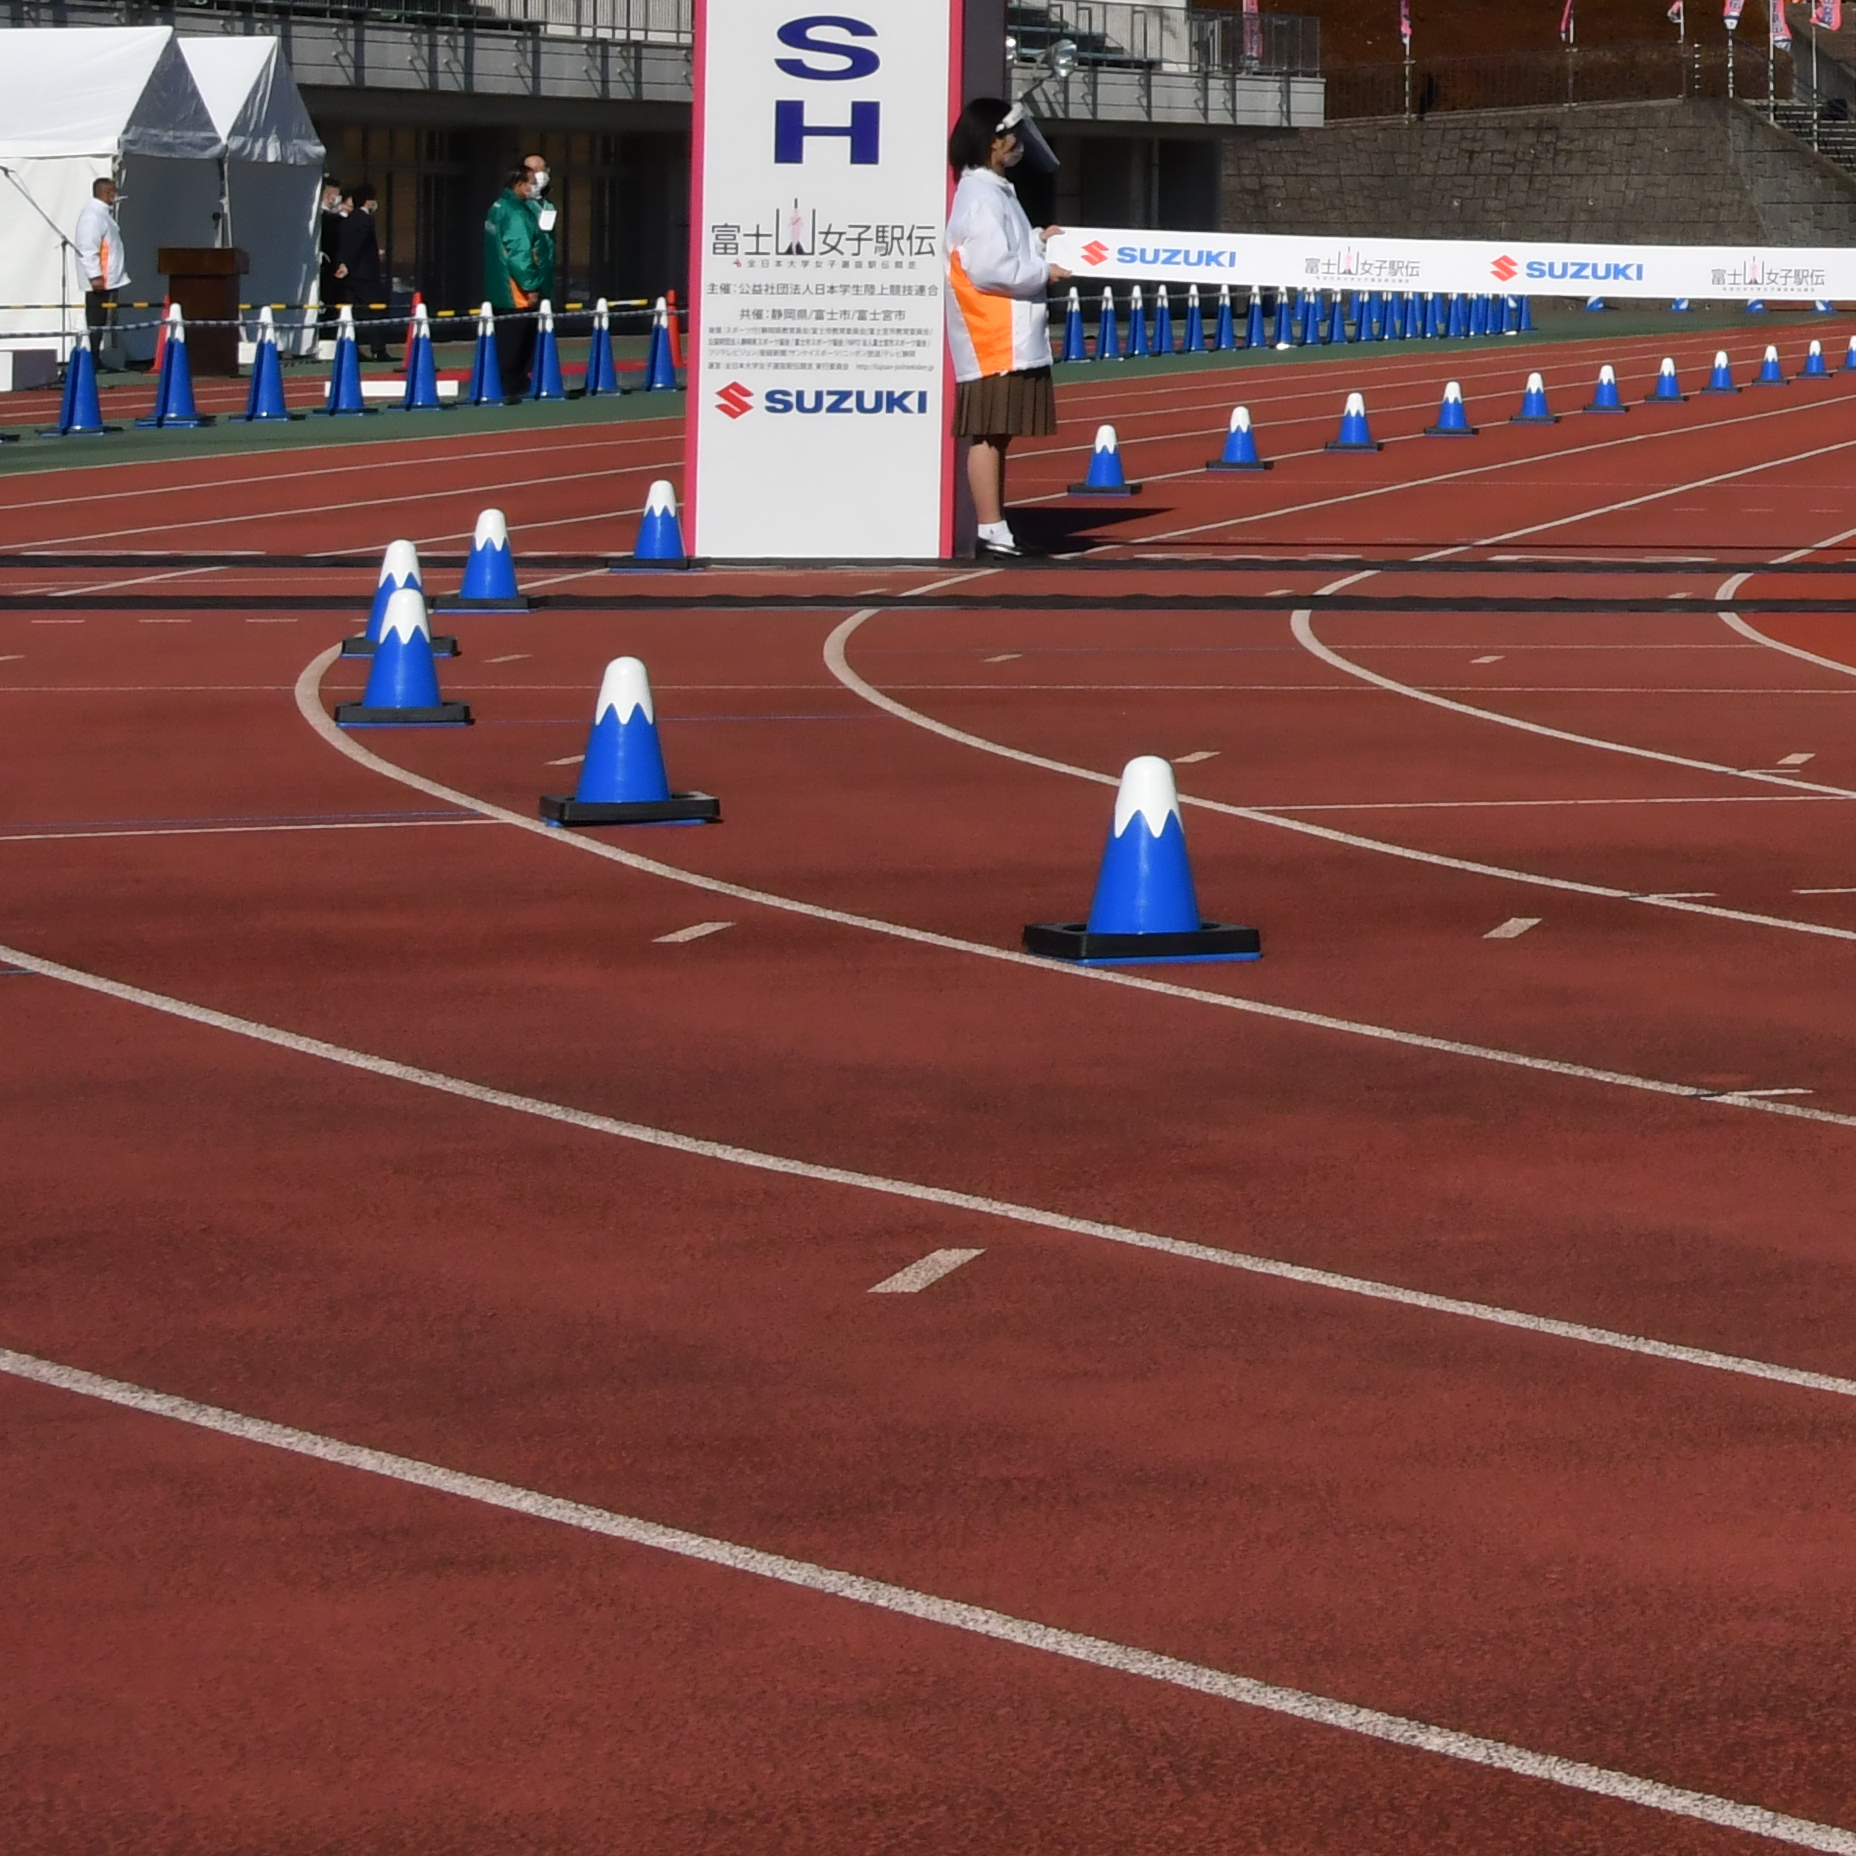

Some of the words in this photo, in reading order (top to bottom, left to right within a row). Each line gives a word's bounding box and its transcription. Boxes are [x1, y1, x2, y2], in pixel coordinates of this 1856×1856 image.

[711, 197, 938, 257] 富士山女子駅伝
[1116, 246, 1237, 268] SUZUKI
[1525, 260, 1644, 281] SUZUKI
[764, 389, 928, 414] SUZUKI
